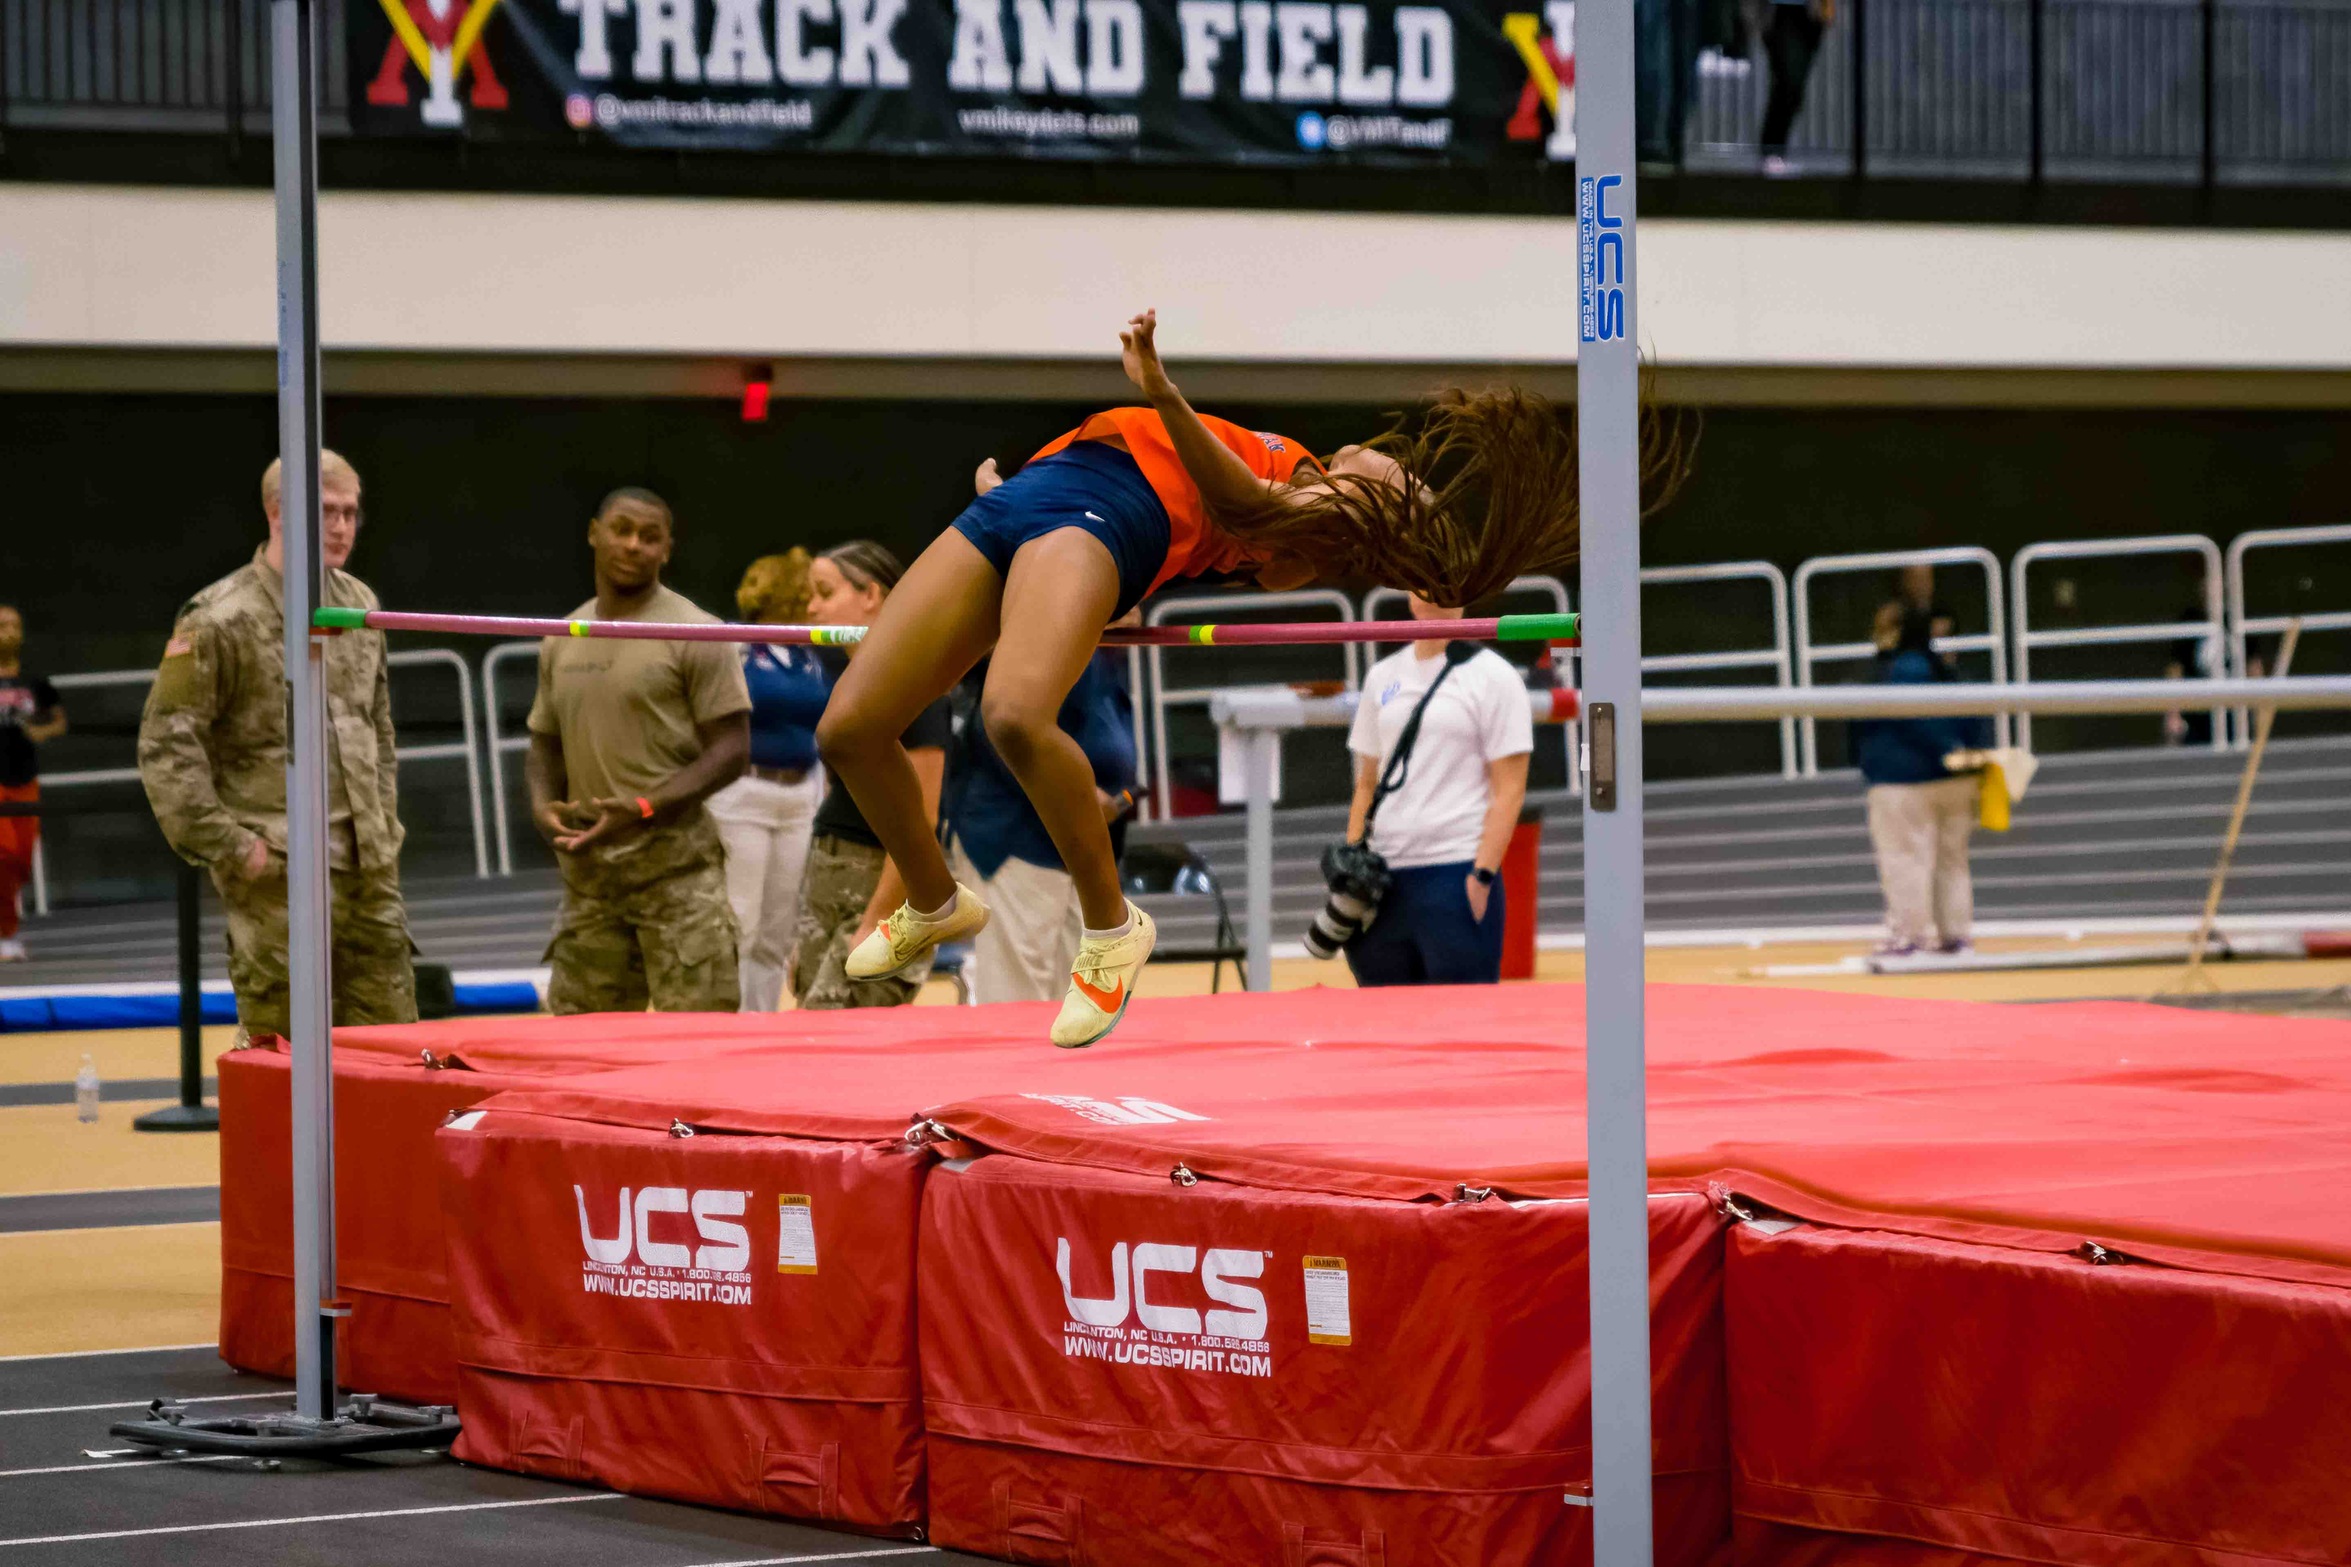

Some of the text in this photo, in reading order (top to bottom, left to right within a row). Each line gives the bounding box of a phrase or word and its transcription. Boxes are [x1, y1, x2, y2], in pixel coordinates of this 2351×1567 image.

[557, 0, 911, 88] TRACK
[947, 0, 1144, 94] AND
[1178, 1, 1454, 104] FIELD
[1582, 181, 1590, 338] WWW.UCSSPIRIT.COM
[1597, 175, 1624, 340] UCS
[573, 1184, 751, 1272] UCS
[630, 1266, 646, 1276] NC
[1056, 1237, 1268, 1341] UCS
[1130, 1329, 1148, 1341] NC
